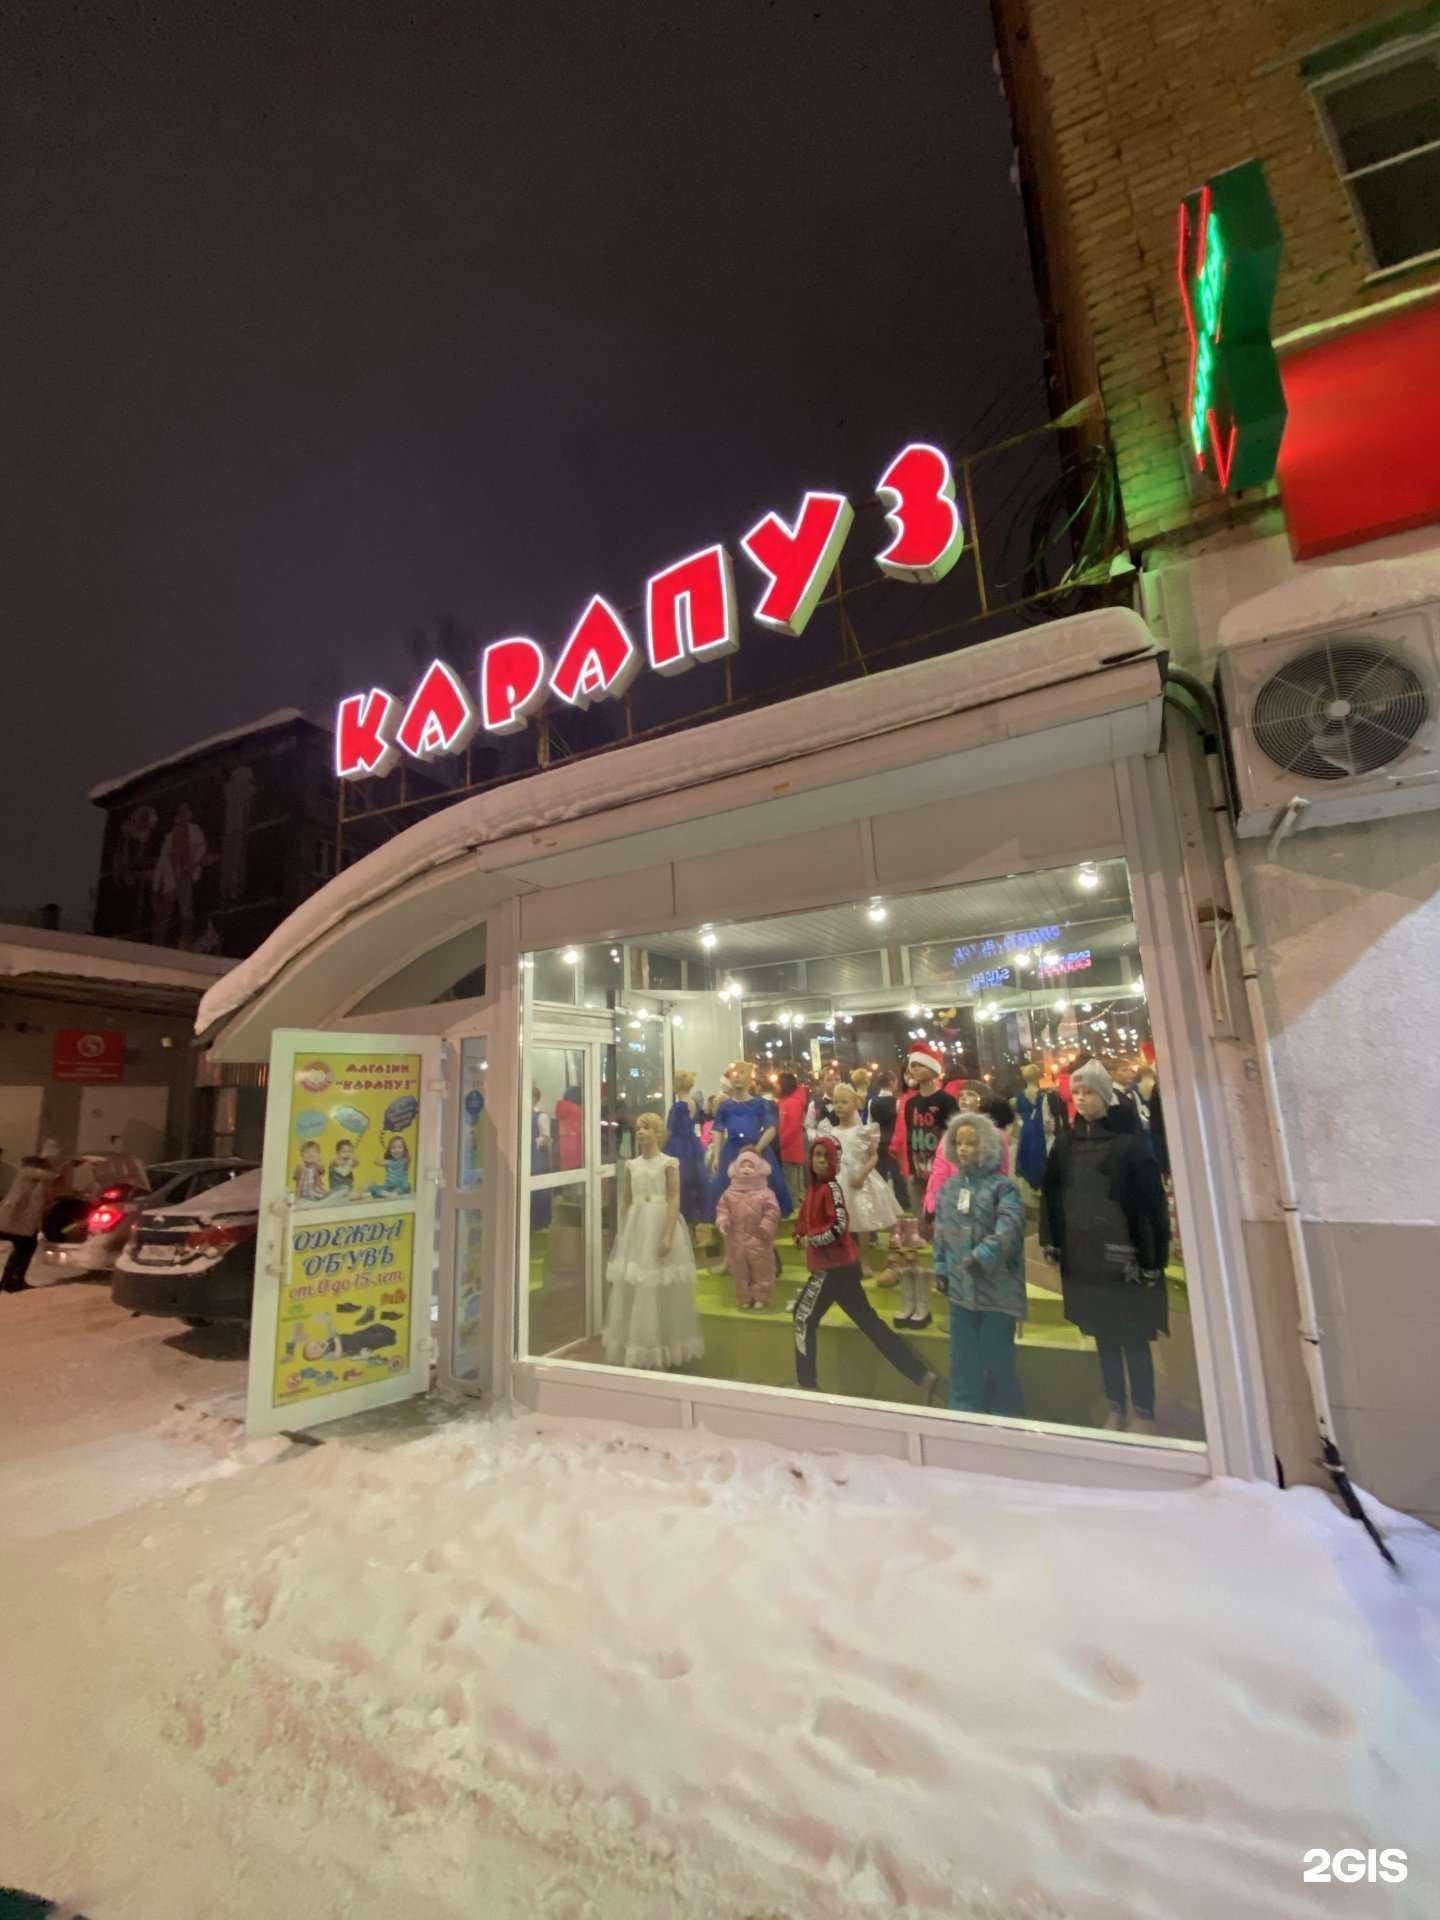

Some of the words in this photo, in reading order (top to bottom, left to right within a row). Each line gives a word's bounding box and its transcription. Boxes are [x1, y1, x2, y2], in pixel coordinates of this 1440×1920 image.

[333, 442, 963, 780] КАРАПУЗ
[293, 1219, 404, 1251] ОДЕЖДА
[303, 1245, 395, 1276] ОБУВЬ
